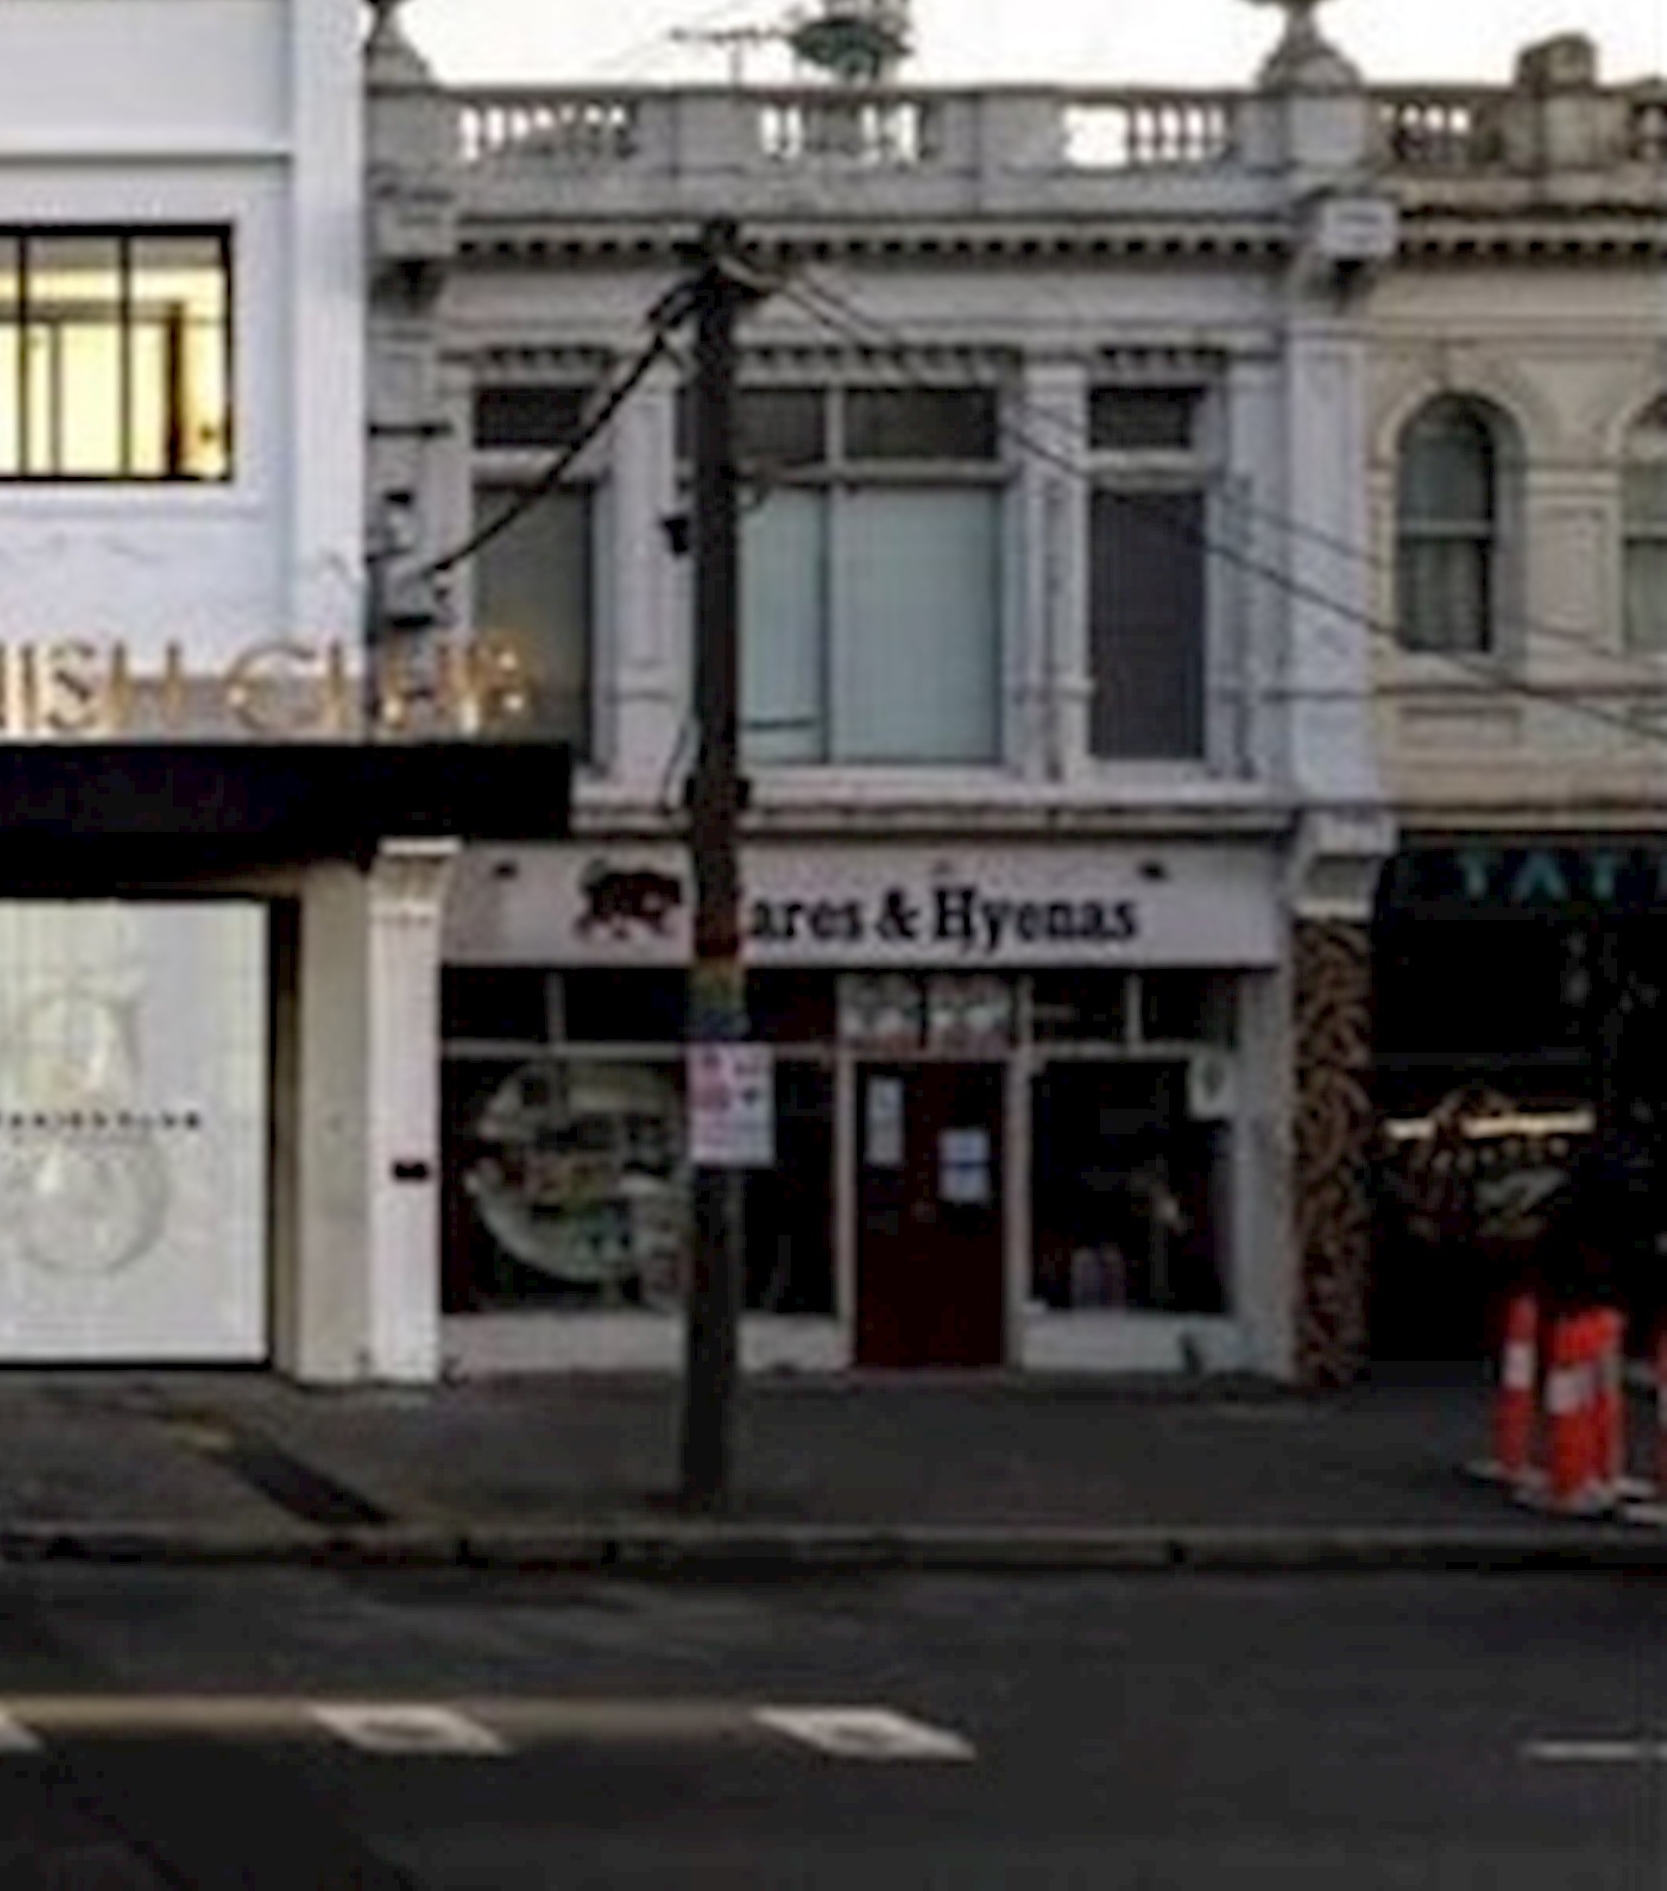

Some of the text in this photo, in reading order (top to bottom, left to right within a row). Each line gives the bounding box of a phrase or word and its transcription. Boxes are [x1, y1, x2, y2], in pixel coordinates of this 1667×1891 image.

[750, 880, 1137, 954] ares & Hyenas
